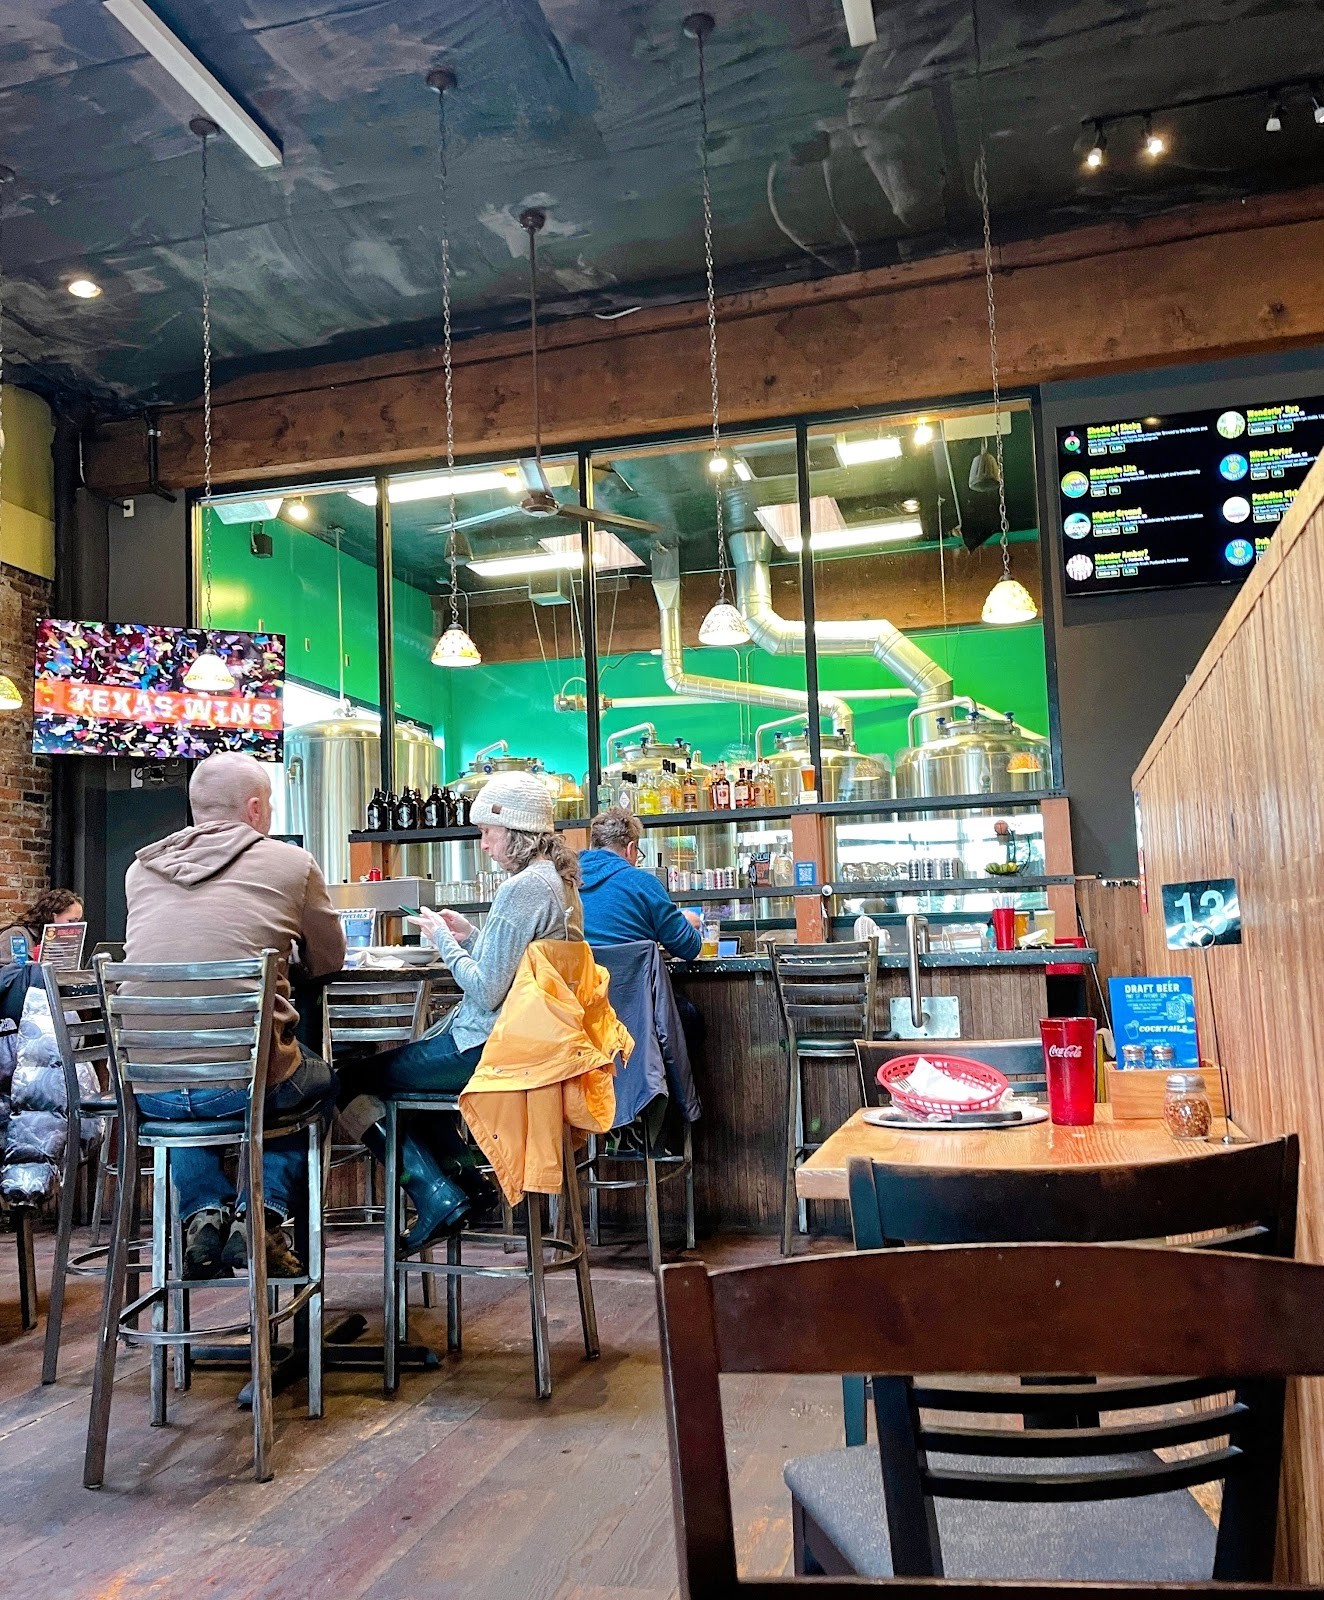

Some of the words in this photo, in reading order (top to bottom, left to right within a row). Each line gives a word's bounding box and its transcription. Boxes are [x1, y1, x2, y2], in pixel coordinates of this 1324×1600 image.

[69, 687, 173, 718] TEXAS
[184, 697, 272, 724] WINS
[1174, 889, 1228, 936] 13
[1124, 983, 1154, 993] DRAFT
[1139, 1025, 1188, 1033] COCKTAILS
[1049, 1044, 1082, 1058] Coca-Cola
